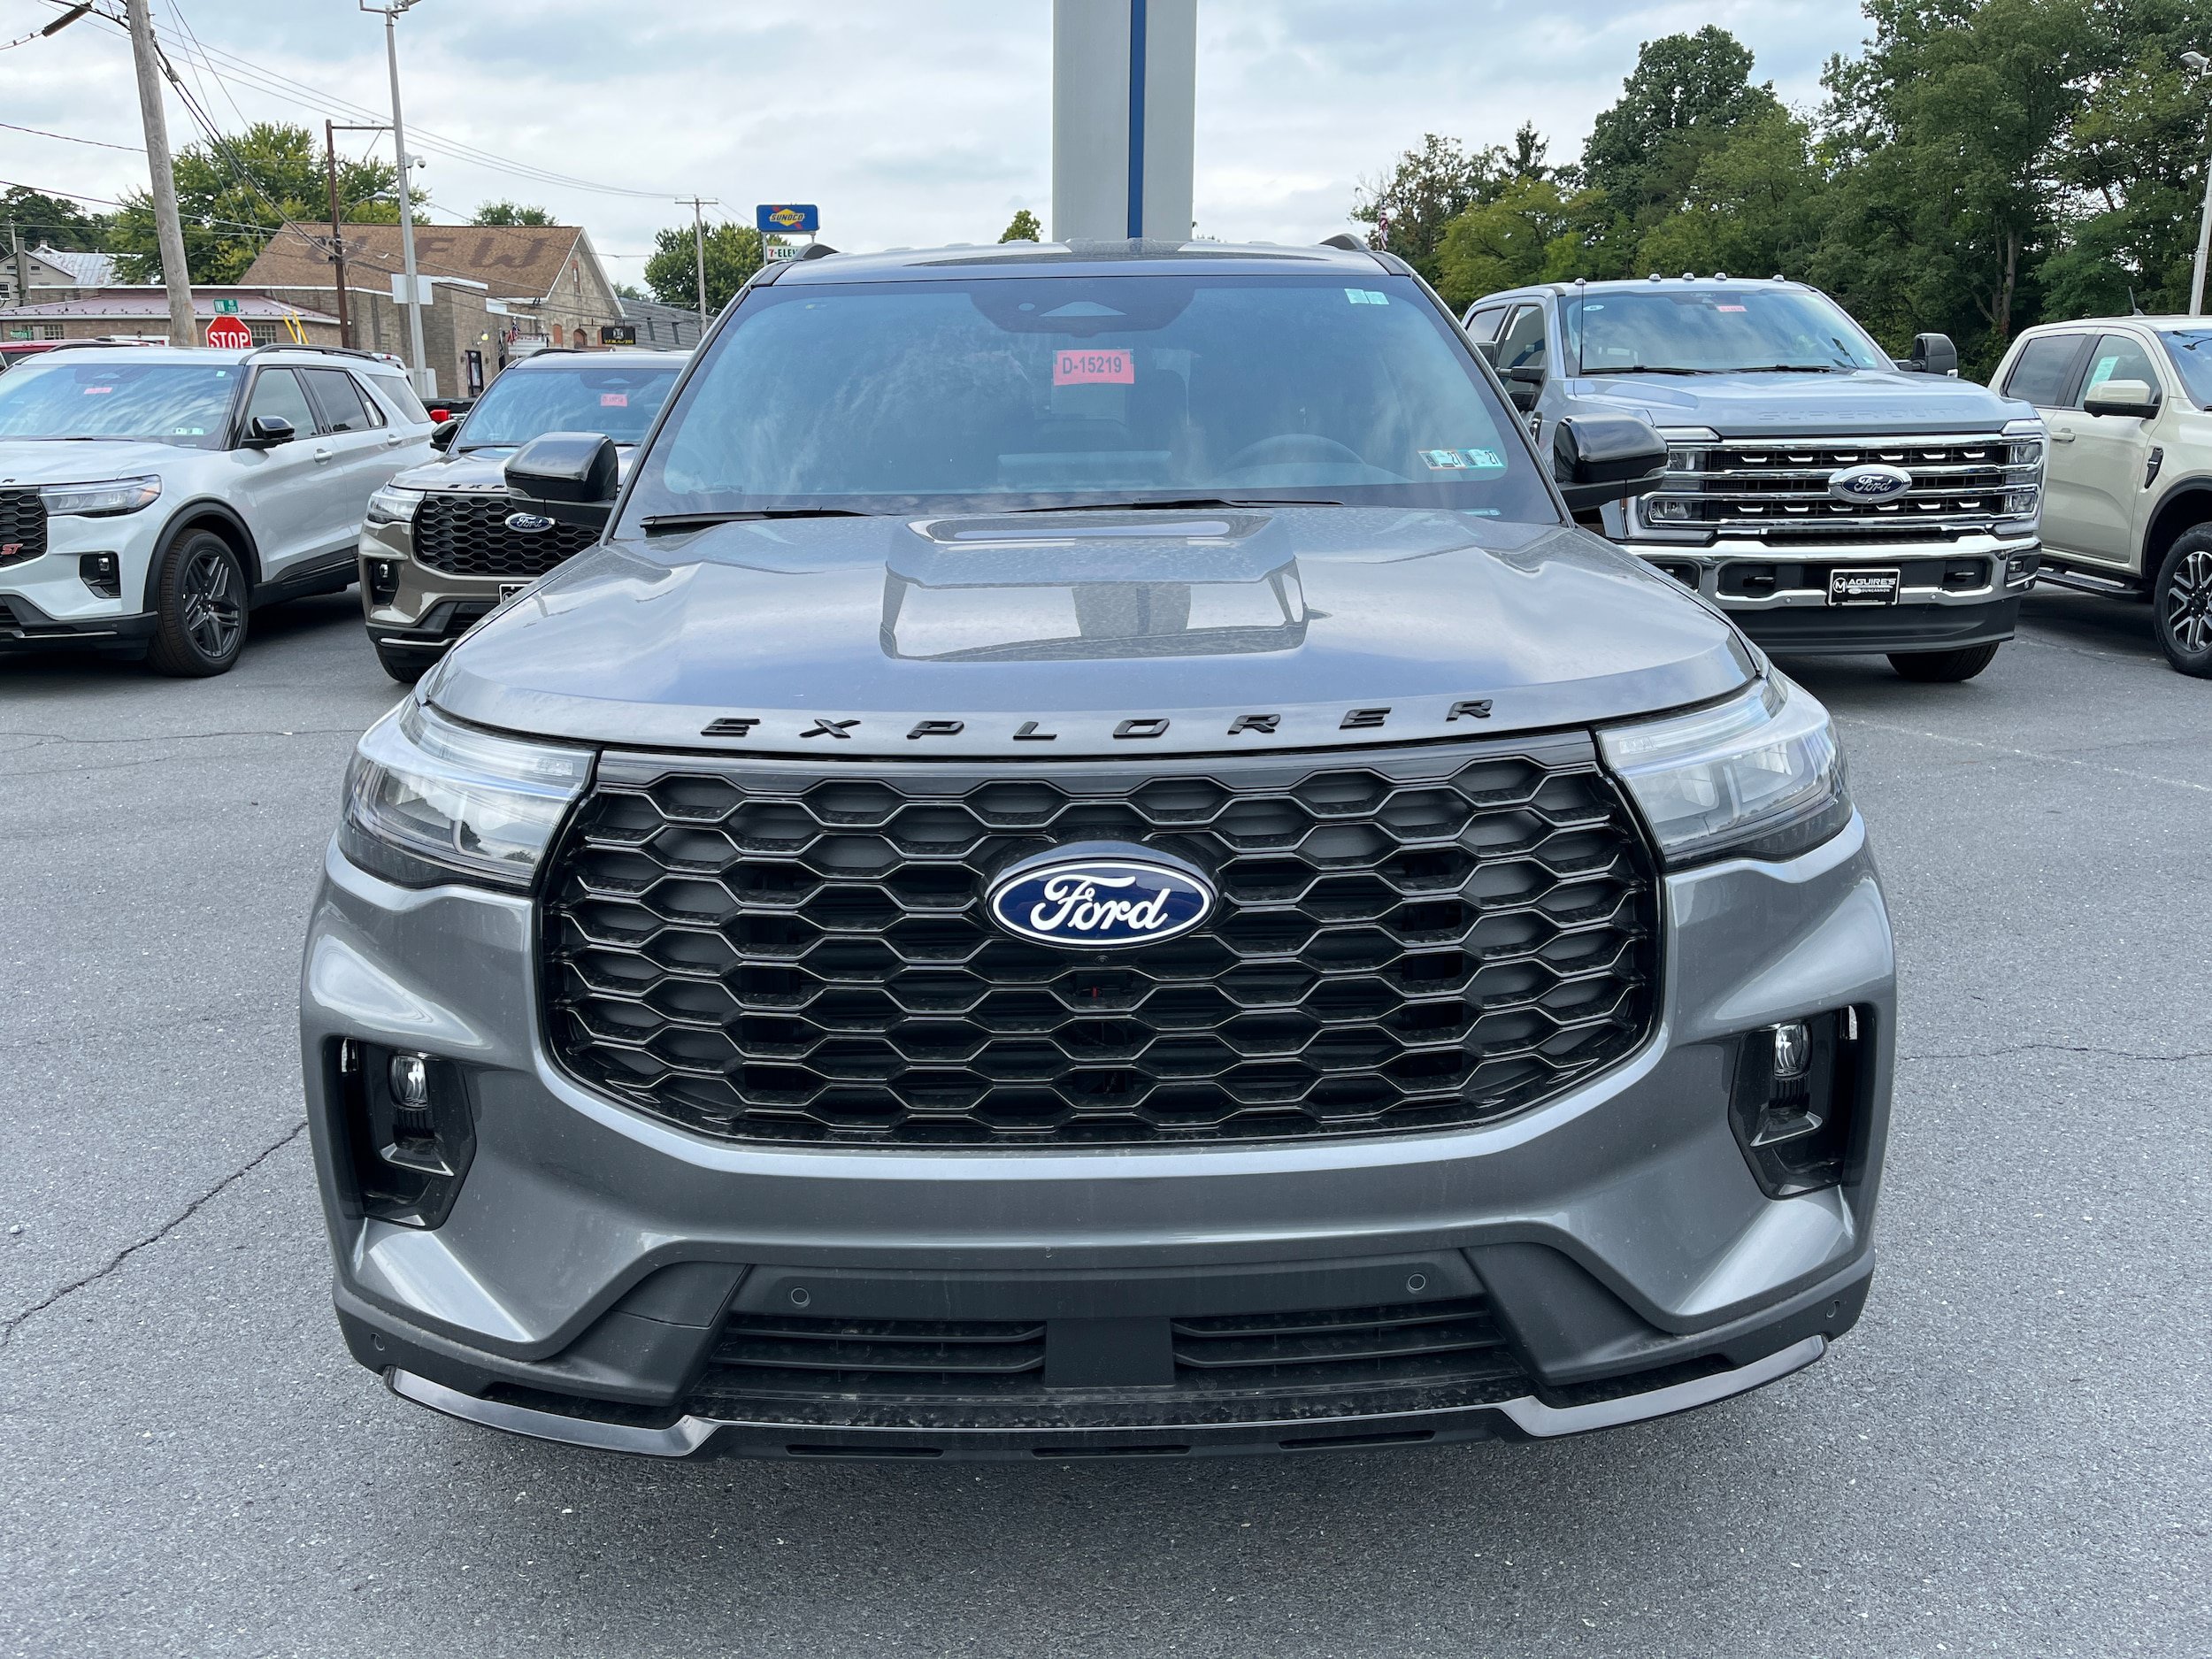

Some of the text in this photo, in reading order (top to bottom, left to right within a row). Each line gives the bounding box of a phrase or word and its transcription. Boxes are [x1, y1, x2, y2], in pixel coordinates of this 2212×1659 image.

[209, 331, 249, 349] STOP
[1062, 356, 1122, 374] D-15219
[1854, 474, 1893, 492] Ford
[1, 543, 24, 555] ST
[700, 699, 1494, 740] EXPLORER
[1029, 873, 1172, 931] Ford
